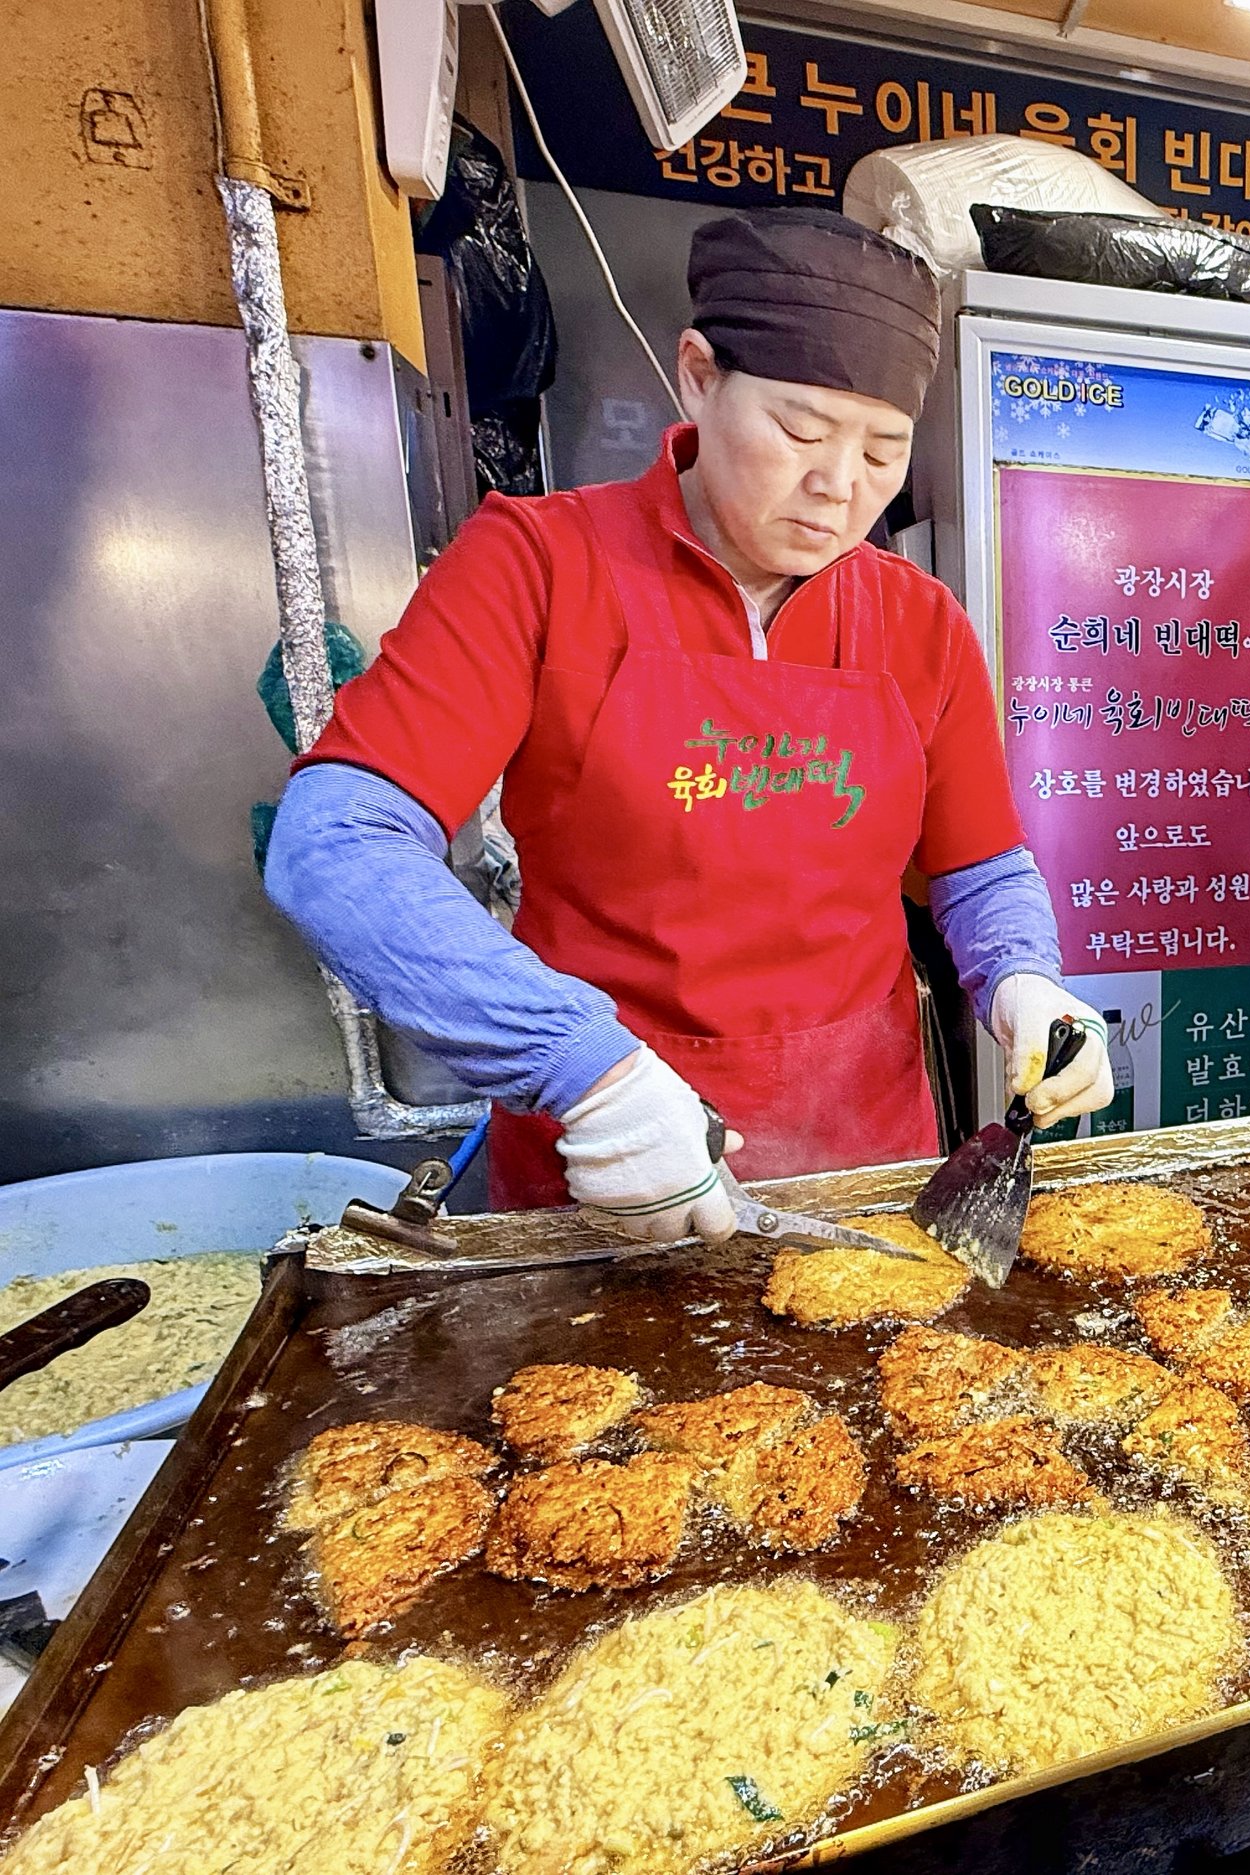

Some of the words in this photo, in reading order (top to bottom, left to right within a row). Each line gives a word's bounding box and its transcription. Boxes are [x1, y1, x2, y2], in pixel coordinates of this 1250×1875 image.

[800, 62, 996, 144] 누이네
[654, 138, 836, 197] 건강하고
[1004, 375, 1077, 402] GOLD
[1081, 382, 1125, 407] ICE
[1114, 564, 1215, 602] 광장시장
[1048, 615, 1141, 657] 순희네
[1011, 676, 1063, 694] 광장시장
[1067, 677, 1093, 693] 통큰
[1008, 697, 1093, 736] 누이네
[1029, 769, 1107, 800] 상호를
[1116, 823, 1212, 852] 앞으로도
[1070, 878, 1120, 908] 많은
[1126, 876, 1198, 906] 사랑과
[1205, 873, 1250, 902] 성원
[1085, 925, 1236, 960] 부탁드립니다.
